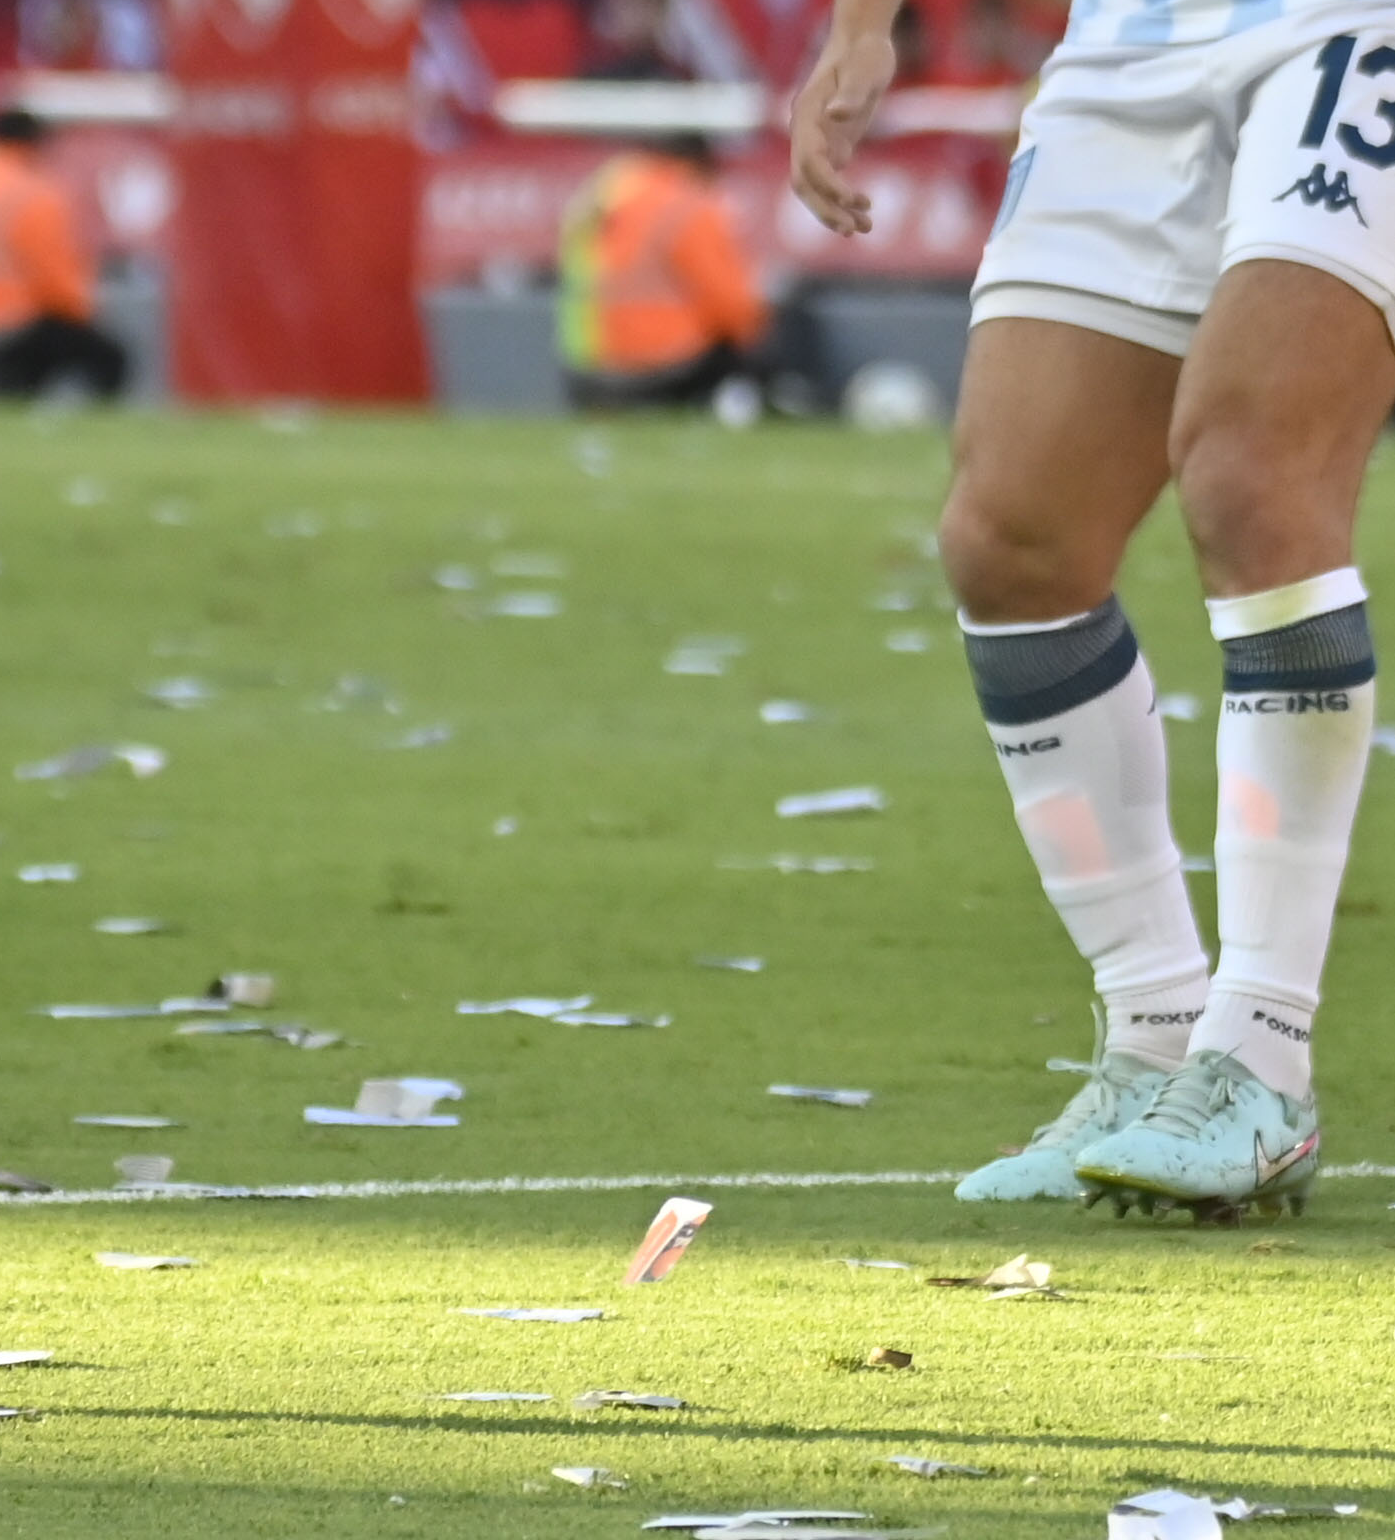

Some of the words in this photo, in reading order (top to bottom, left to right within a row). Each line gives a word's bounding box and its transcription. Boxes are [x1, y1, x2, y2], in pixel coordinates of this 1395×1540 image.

[1297, 34, 1395, 171] 13
[1225, 693, 1350, 715] RACING
[995, 736, 1062, 758] ING
